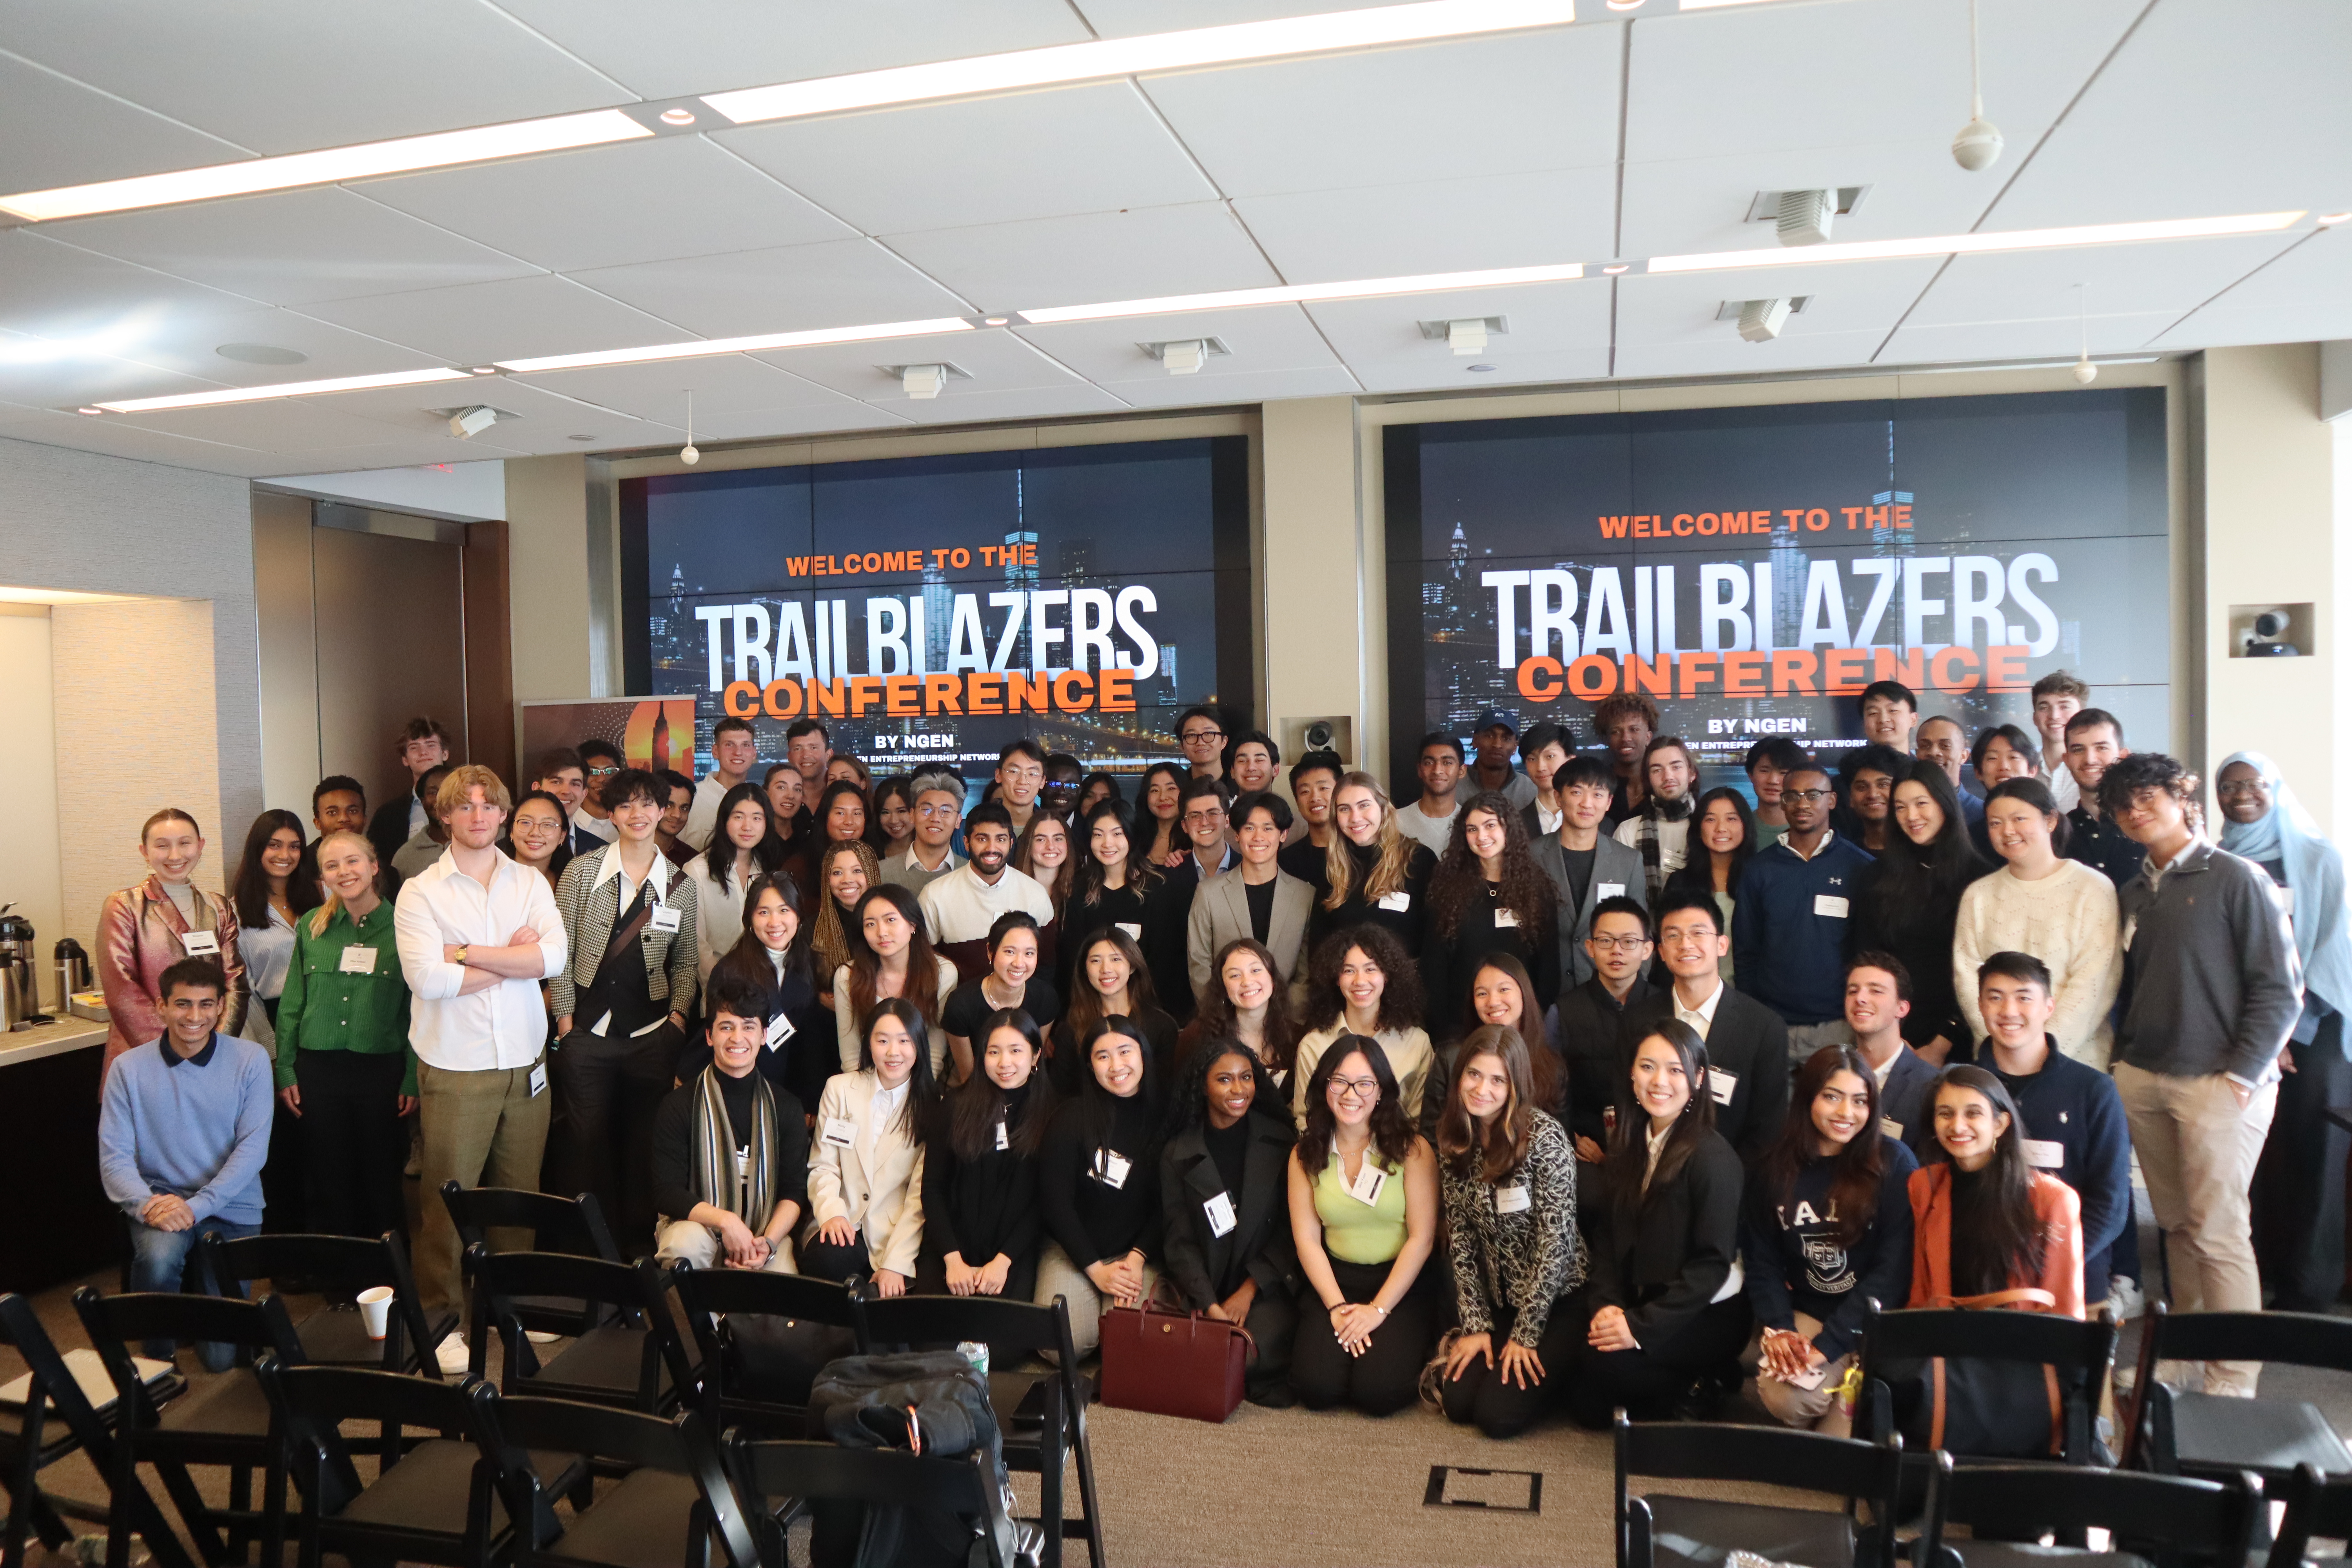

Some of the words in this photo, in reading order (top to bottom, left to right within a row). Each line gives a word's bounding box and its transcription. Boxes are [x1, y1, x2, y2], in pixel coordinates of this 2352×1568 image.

[1598, 510, 1771, 539] WELCOME
[1782, 508, 1831, 532] TO
[1840, 505, 1913, 530] THE
[786, 550, 923, 576] WELCOME
[932, 548, 971, 569] TO
[979, 544, 1037, 566] THE
[1481, 552, 2059, 669] TRAILBLAZERS
[695, 585, 1159, 692] TRAILBLAZERS
[1517, 645, 2031, 702] CONFERENCE
[724, 668, 1136, 721] CONFERENCE
[875, 735, 898, 749] BY
[904, 734, 954, 748] NGEN
[1708, 719, 1738, 734] BY
[1744, 718, 1807, 733] NGEN
[870, 754, 958, 763] ENTREPRENEURSHIP
[1813, 739, 1868, 748] NETWORK
